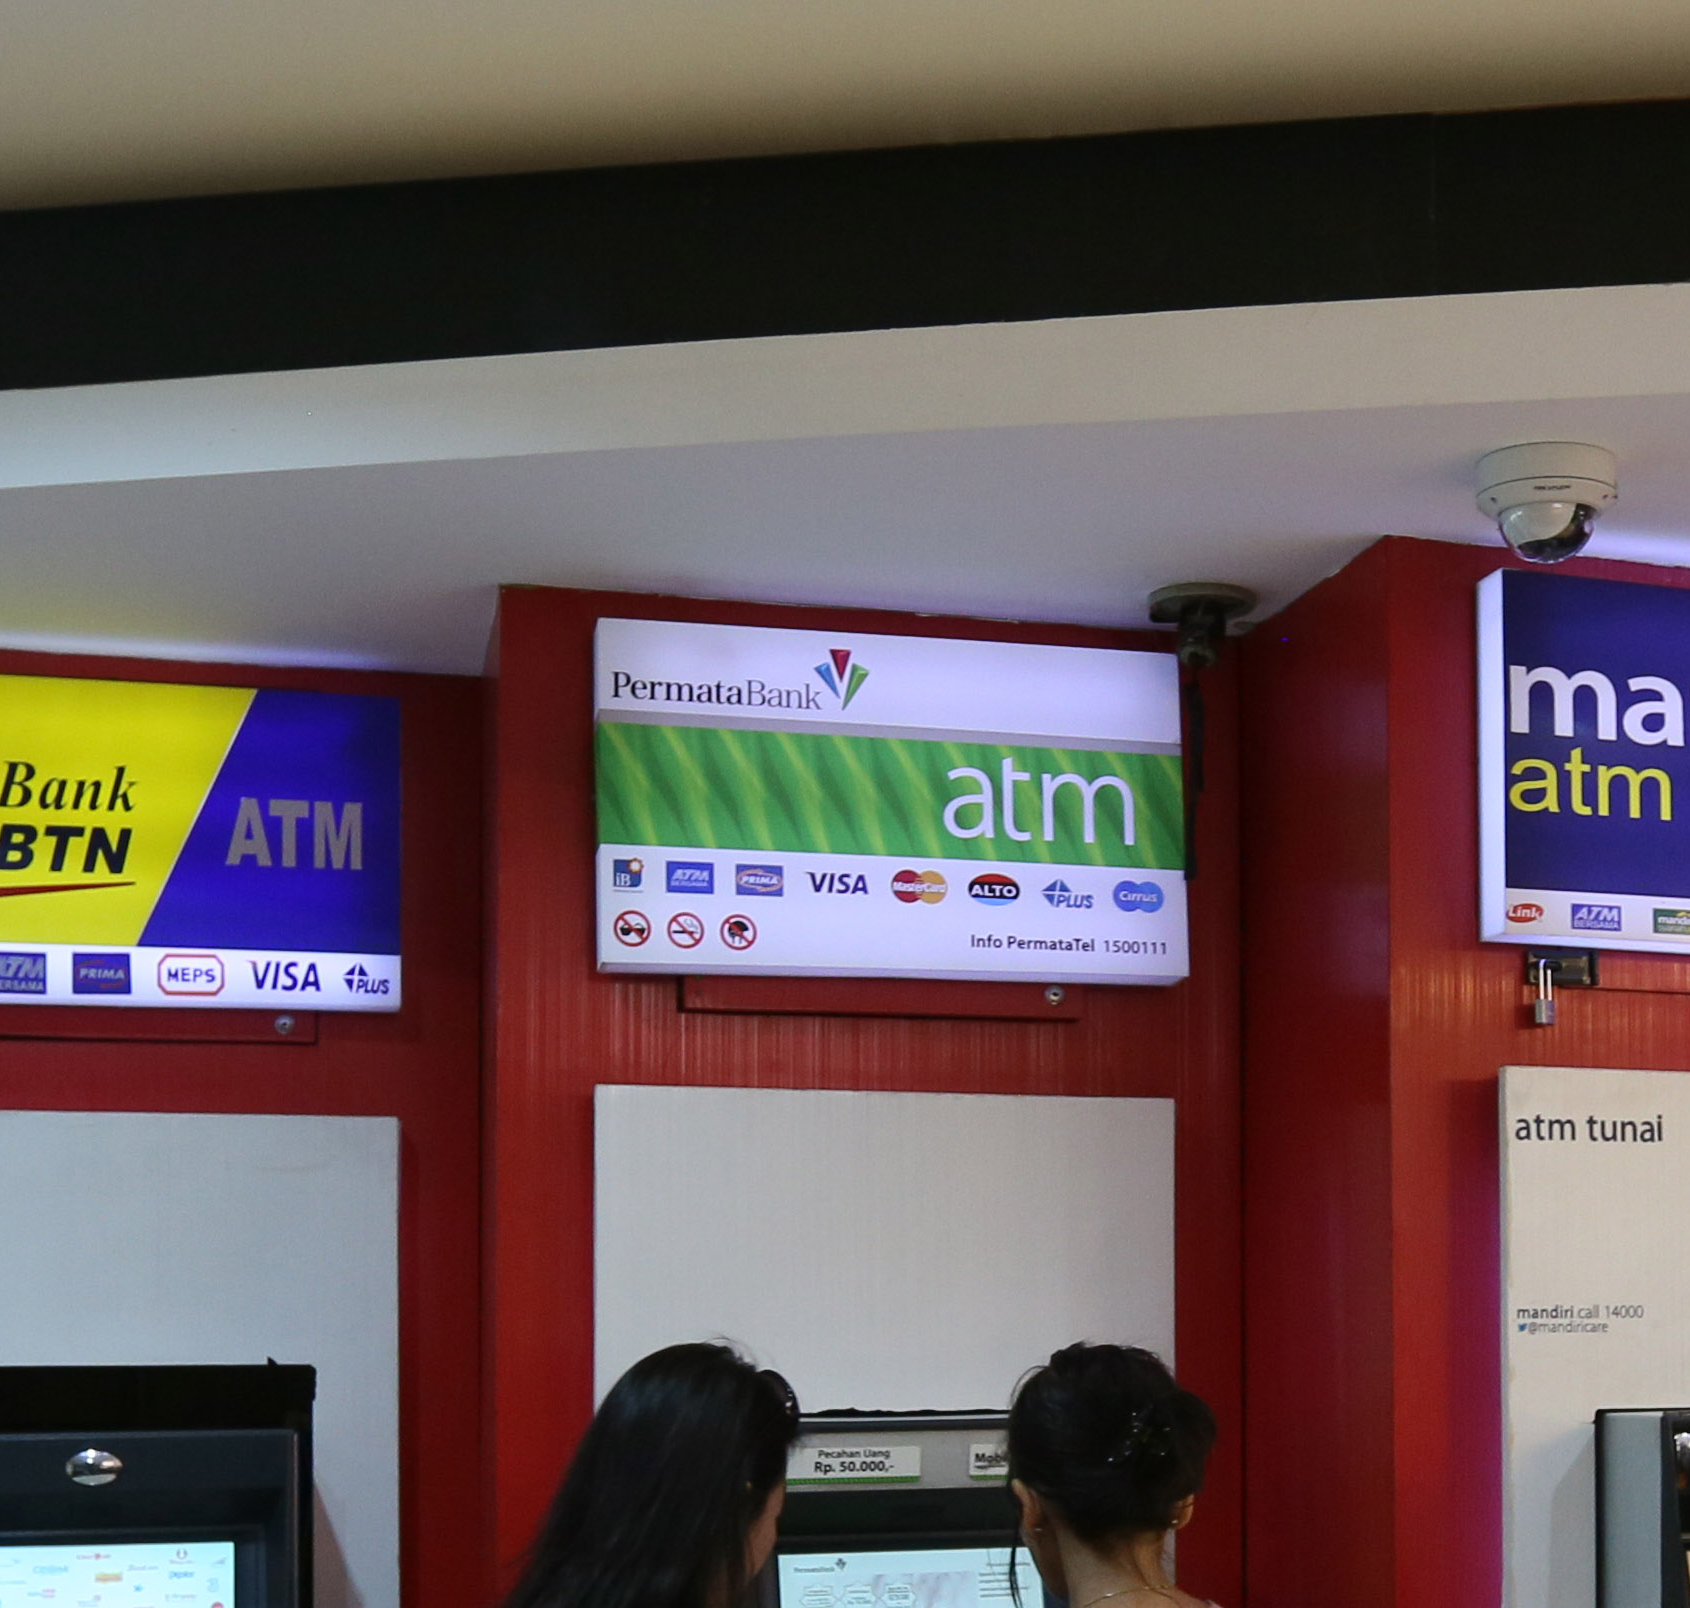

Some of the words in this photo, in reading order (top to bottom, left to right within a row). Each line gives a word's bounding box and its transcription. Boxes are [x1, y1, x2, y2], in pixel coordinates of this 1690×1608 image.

[611, 670, 823, 711] PermataBank
[1508, 746, 1672, 821] atm
[943, 756, 1135, 846] atm
[225, 797, 362, 870] ATM
[740, 875, 779, 885] PRIMA
[806, 871, 869, 894] VISA
[970, 884, 1017, 897] ALTO
[1119, 890, 1157, 902] Cirrus
[1057, 893, 1094, 909] PLUS
[1509, 905, 1542, 920] Link
[1575, 906, 1619, 920] ATM
[971, 934, 1003, 949] Info
[1007, 935, 1095, 953] PermataTel
[1104, 940, 1167, 955] 1500111
[79, 966, 124, 982] PRIMA
[167, 967, 216, 984] MEPS
[247, 960, 322, 993] VISA
[355, 975, 389, 995] PLUS
[1515, 1116, 1576, 1142] atm
[1586, 1114, 1663, 1142] tunai
[1517, 1304, 1573, 1319] mandiri
[1578, 1304, 1599, 1318] call
[1605, 1305, 1644, 1318] 14000
[818, 1449, 859, 1459] Pecahan
[864, 1449, 891, 1460] Uang
[814, 1461, 836, 1475] Rp.
